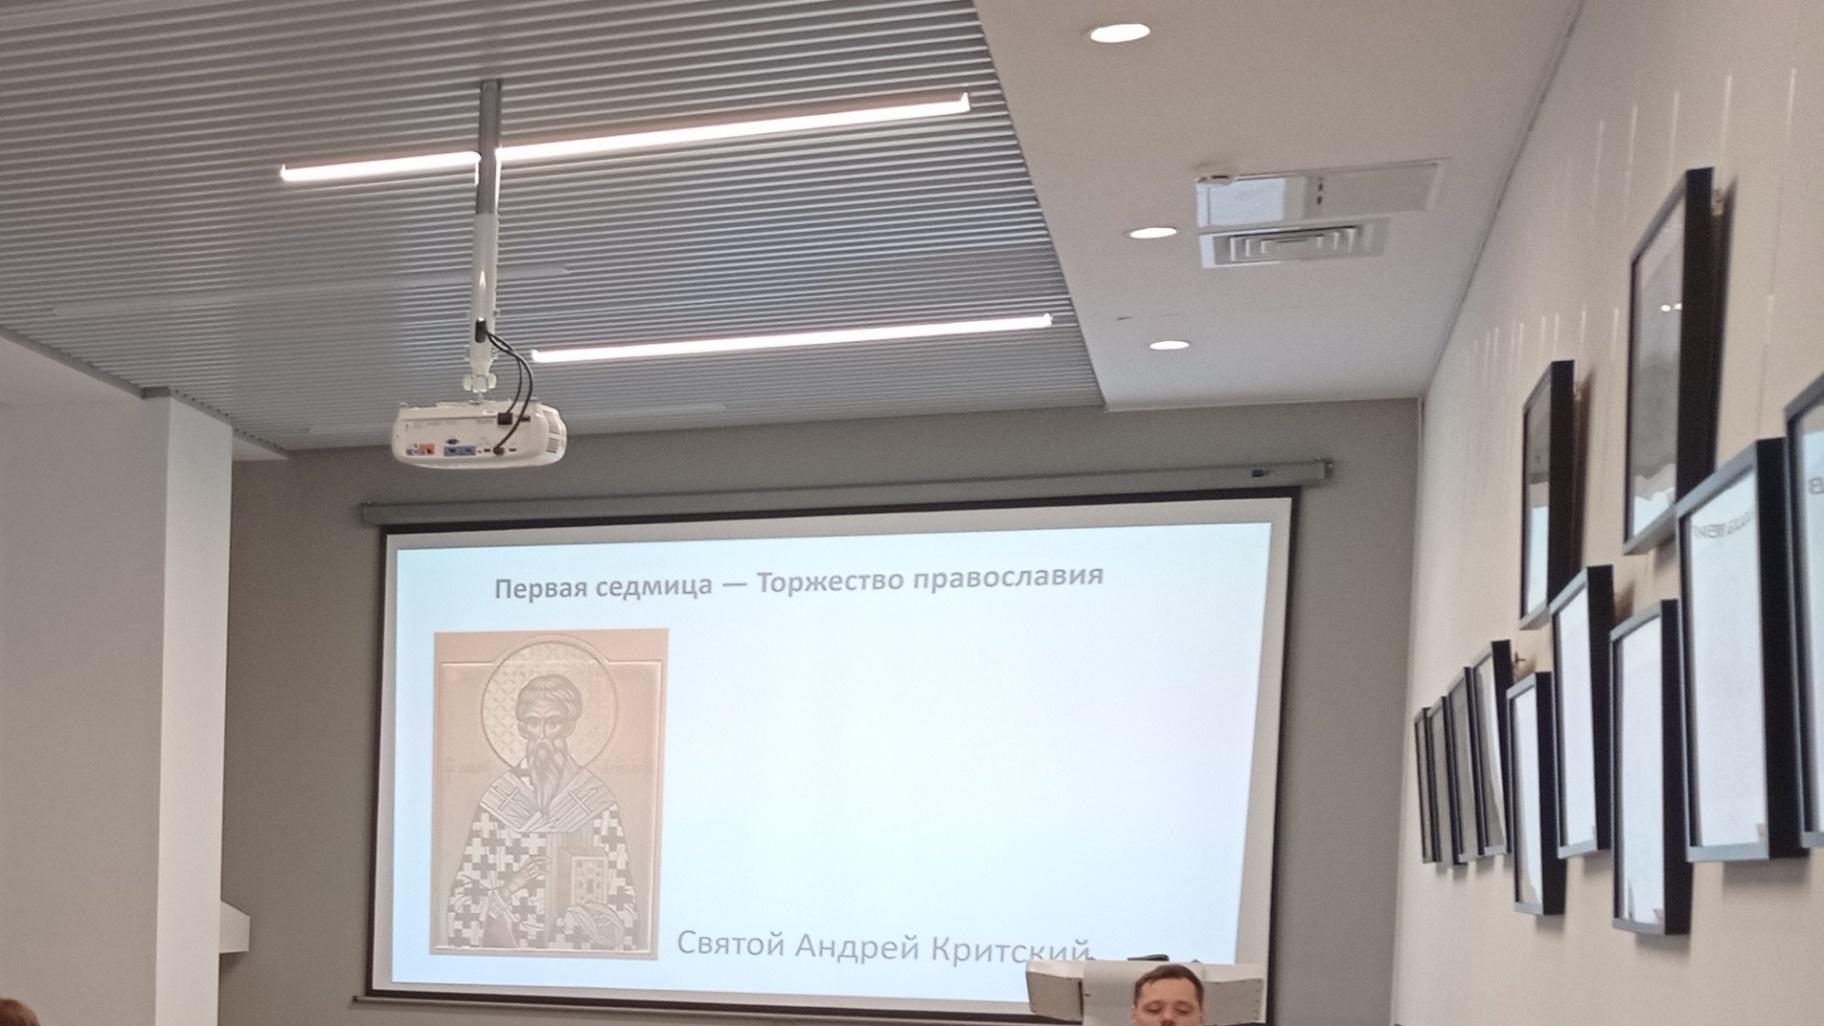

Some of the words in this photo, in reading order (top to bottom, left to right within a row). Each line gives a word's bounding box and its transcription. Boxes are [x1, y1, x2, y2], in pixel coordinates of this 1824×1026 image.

[494, 578, 588, 603] Первая
[595, 577, 713, 600] седмица
[756, 571, 905, 598] Торжество
[913, 567, 1105, 595] православия
[677, 929, 785, 957] Святой
[794, 932, 920, 965] Андрей
[931, 935, 1090, 968] Критский
